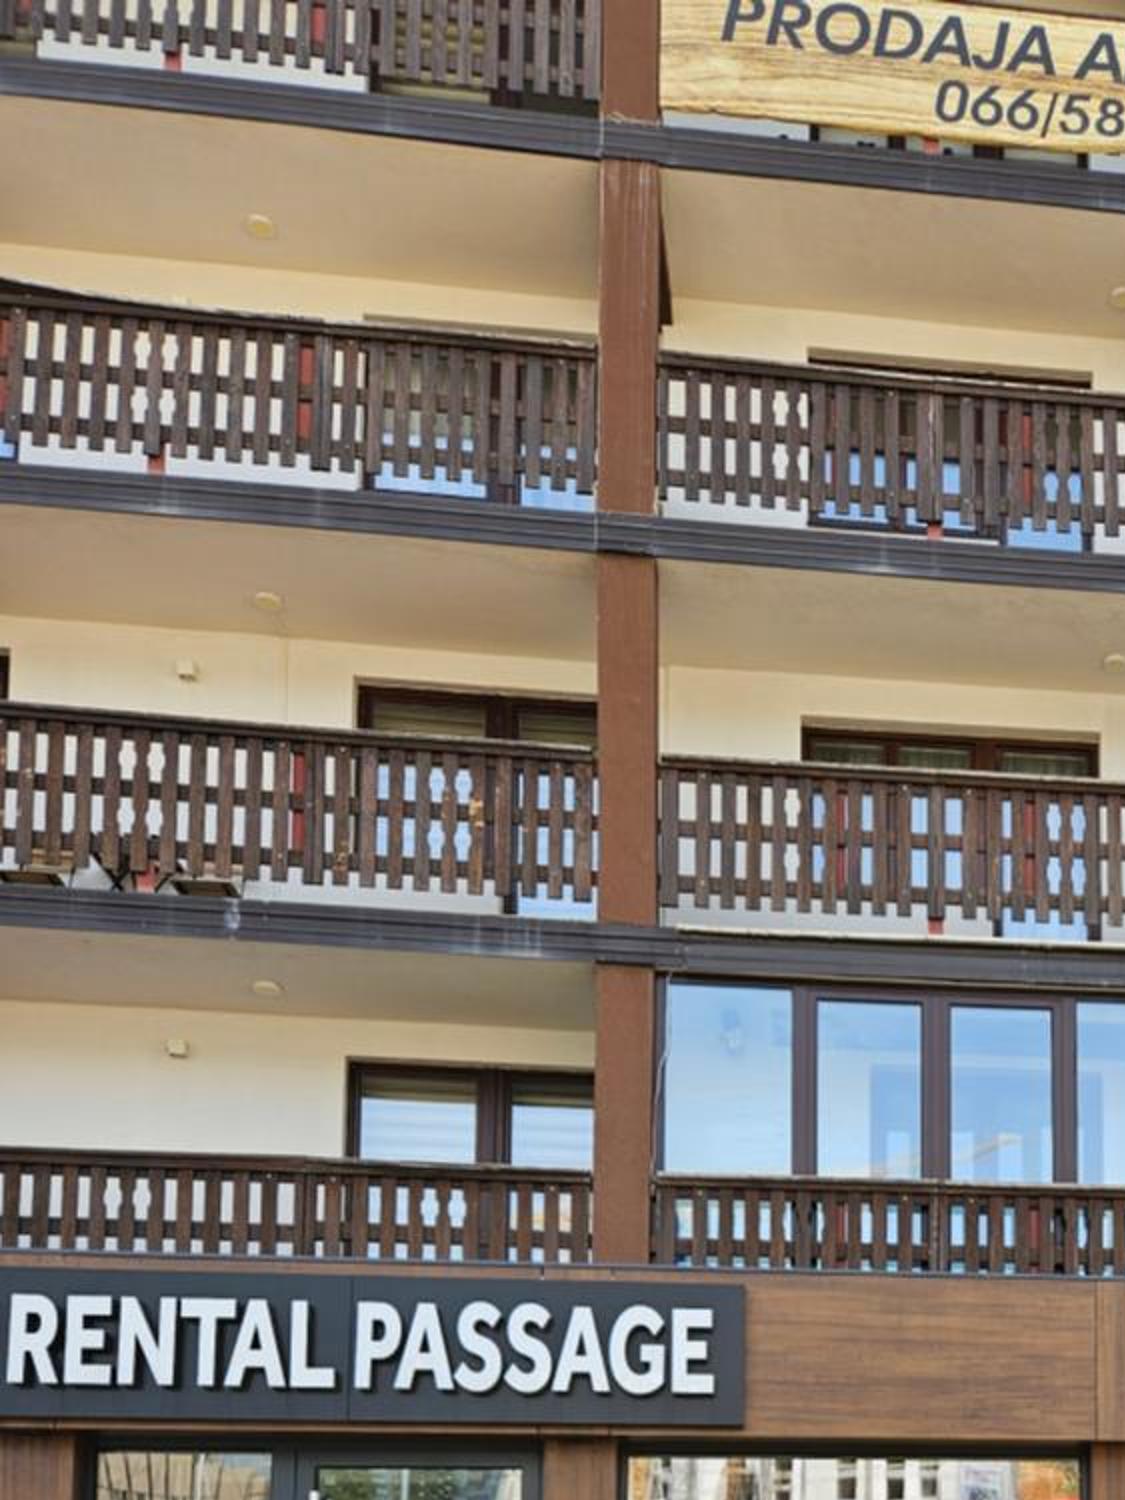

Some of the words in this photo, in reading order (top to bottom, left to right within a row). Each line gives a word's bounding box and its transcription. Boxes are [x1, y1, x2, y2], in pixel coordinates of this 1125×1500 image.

[721, 0, 1056, 77] PRODAJA
[5, 1294, 336, 1389] RENTAL
[353, 1301, 715, 1396] PASSAGE
